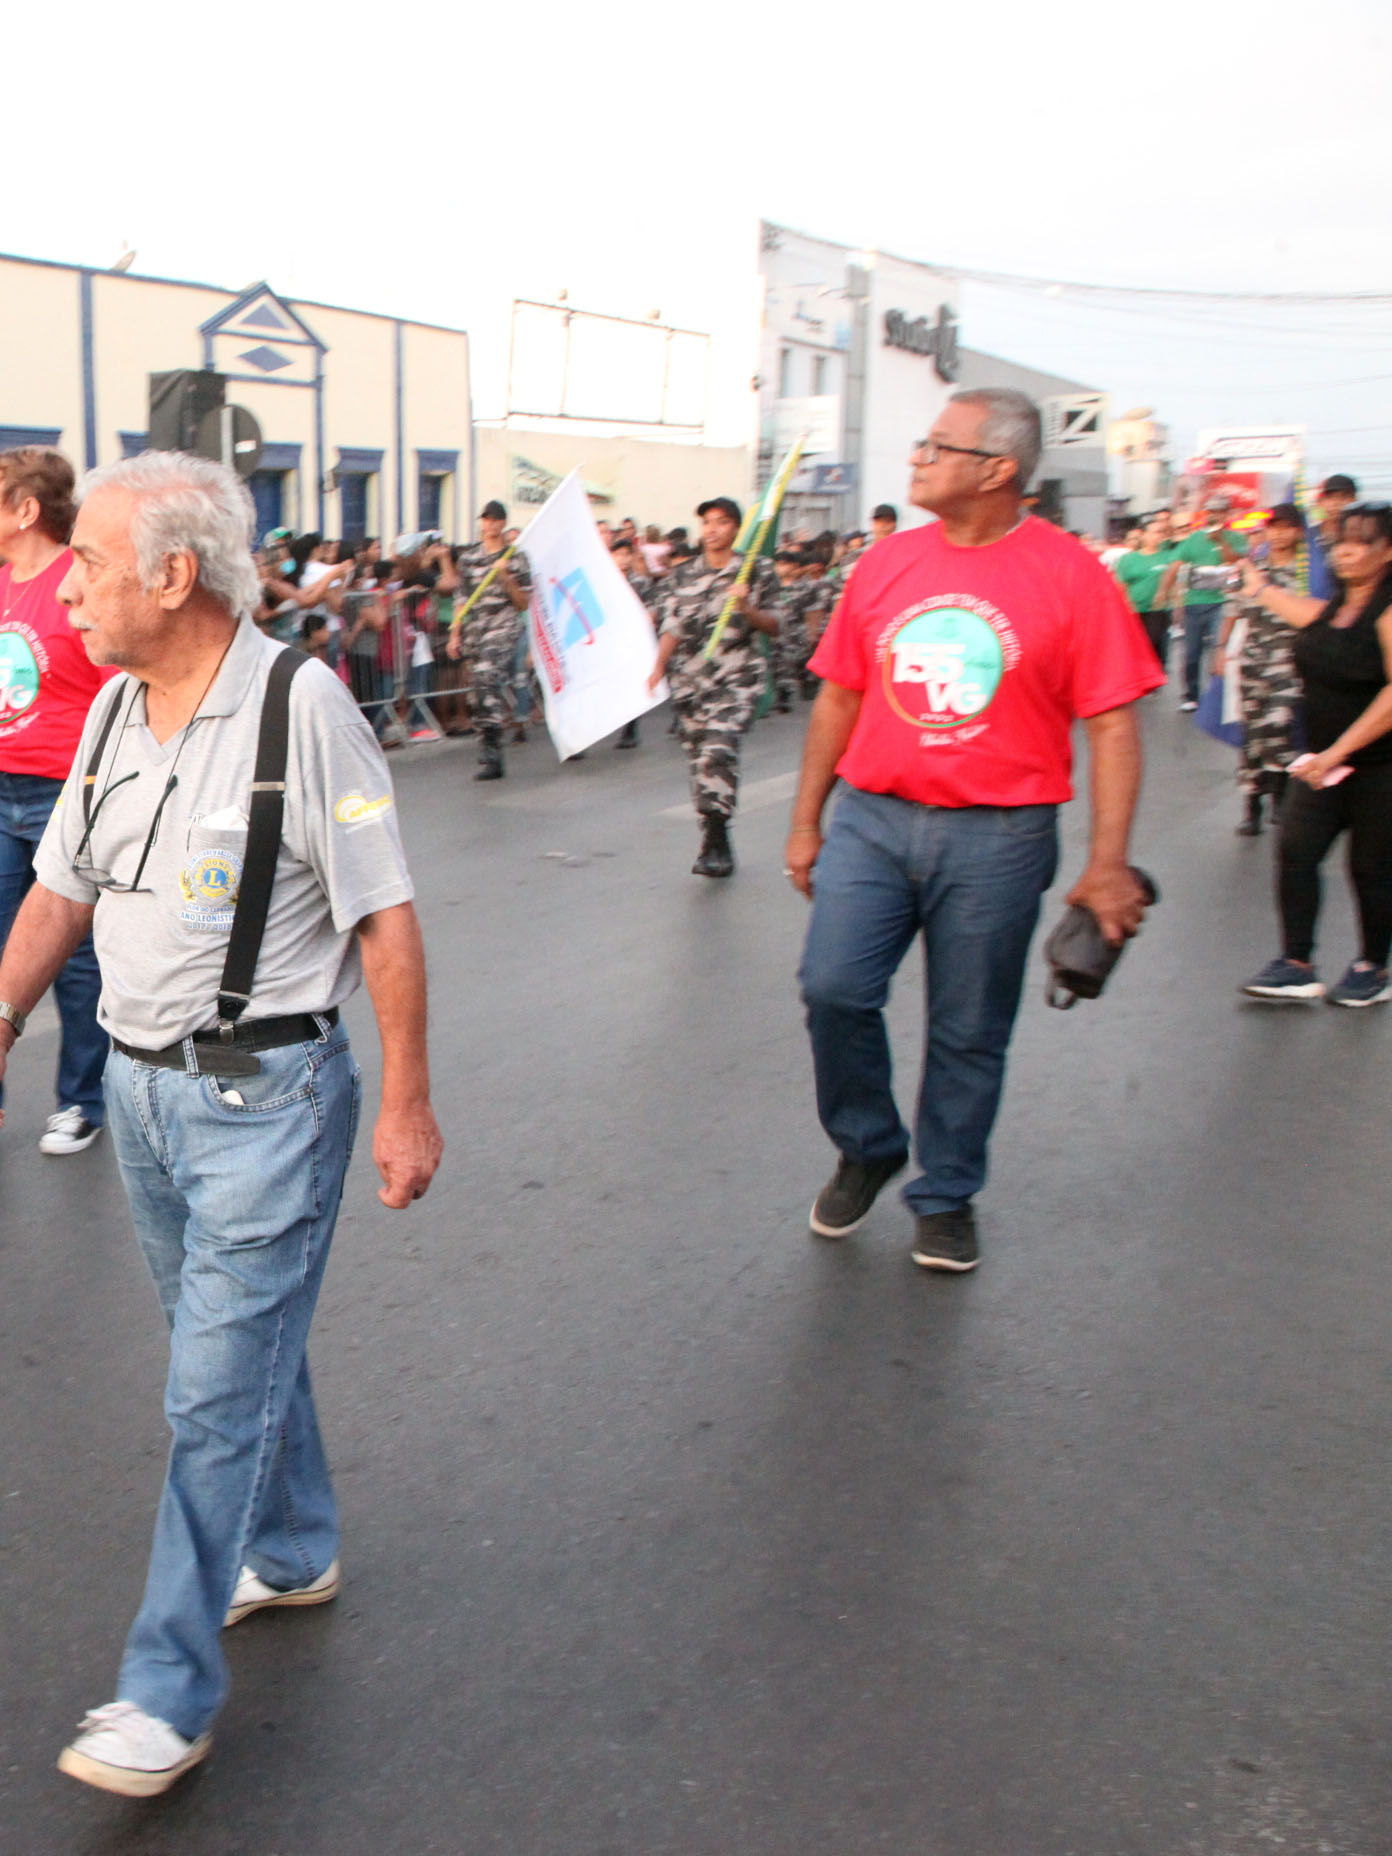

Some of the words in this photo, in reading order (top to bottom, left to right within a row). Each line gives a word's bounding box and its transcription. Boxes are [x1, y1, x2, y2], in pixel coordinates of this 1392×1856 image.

[891, 643, 966, 683] 155
[925, 681, 988, 715] VG
[180, 911, 196, 921] ANO
